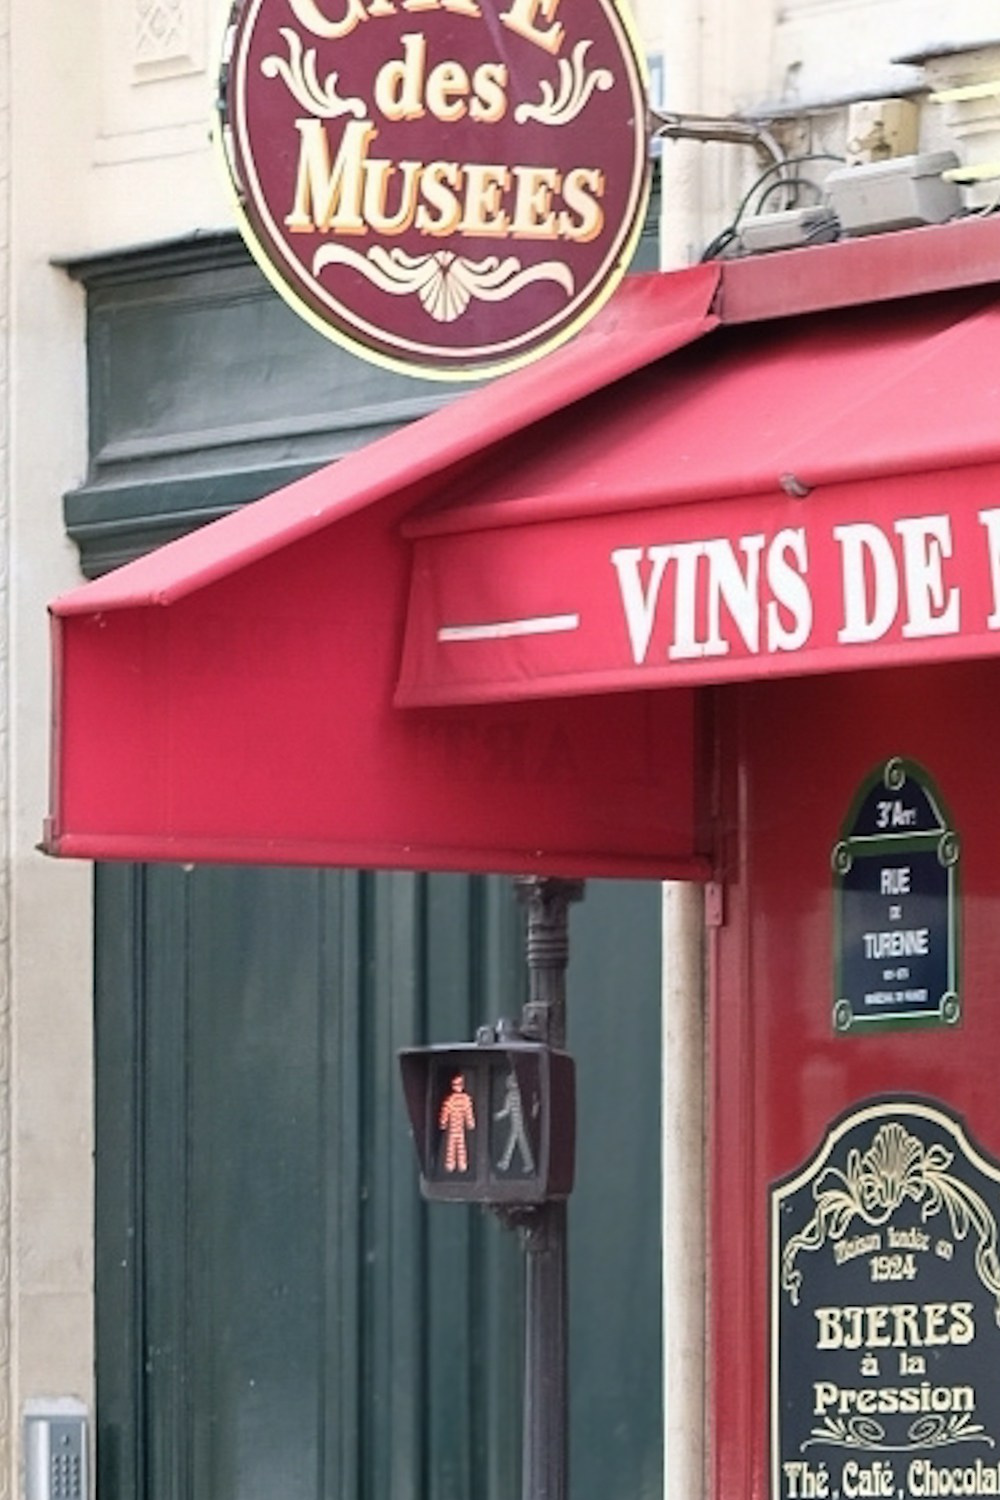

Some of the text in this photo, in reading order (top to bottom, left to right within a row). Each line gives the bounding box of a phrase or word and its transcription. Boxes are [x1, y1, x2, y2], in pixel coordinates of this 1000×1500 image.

[373, 33, 509, 122] des
[285, 118, 605, 242] MUSEES
[611, 527, 813, 664] VINS
[833, 514, 961, 644] DE
[880, 867, 911, 895] RUE
[862, 928, 929, 959] TURENNE
[869, 1253, 918, 1282] 1924
[899, 1351, 926, 1376] la
[813, 1382, 975, 1416] Pression
